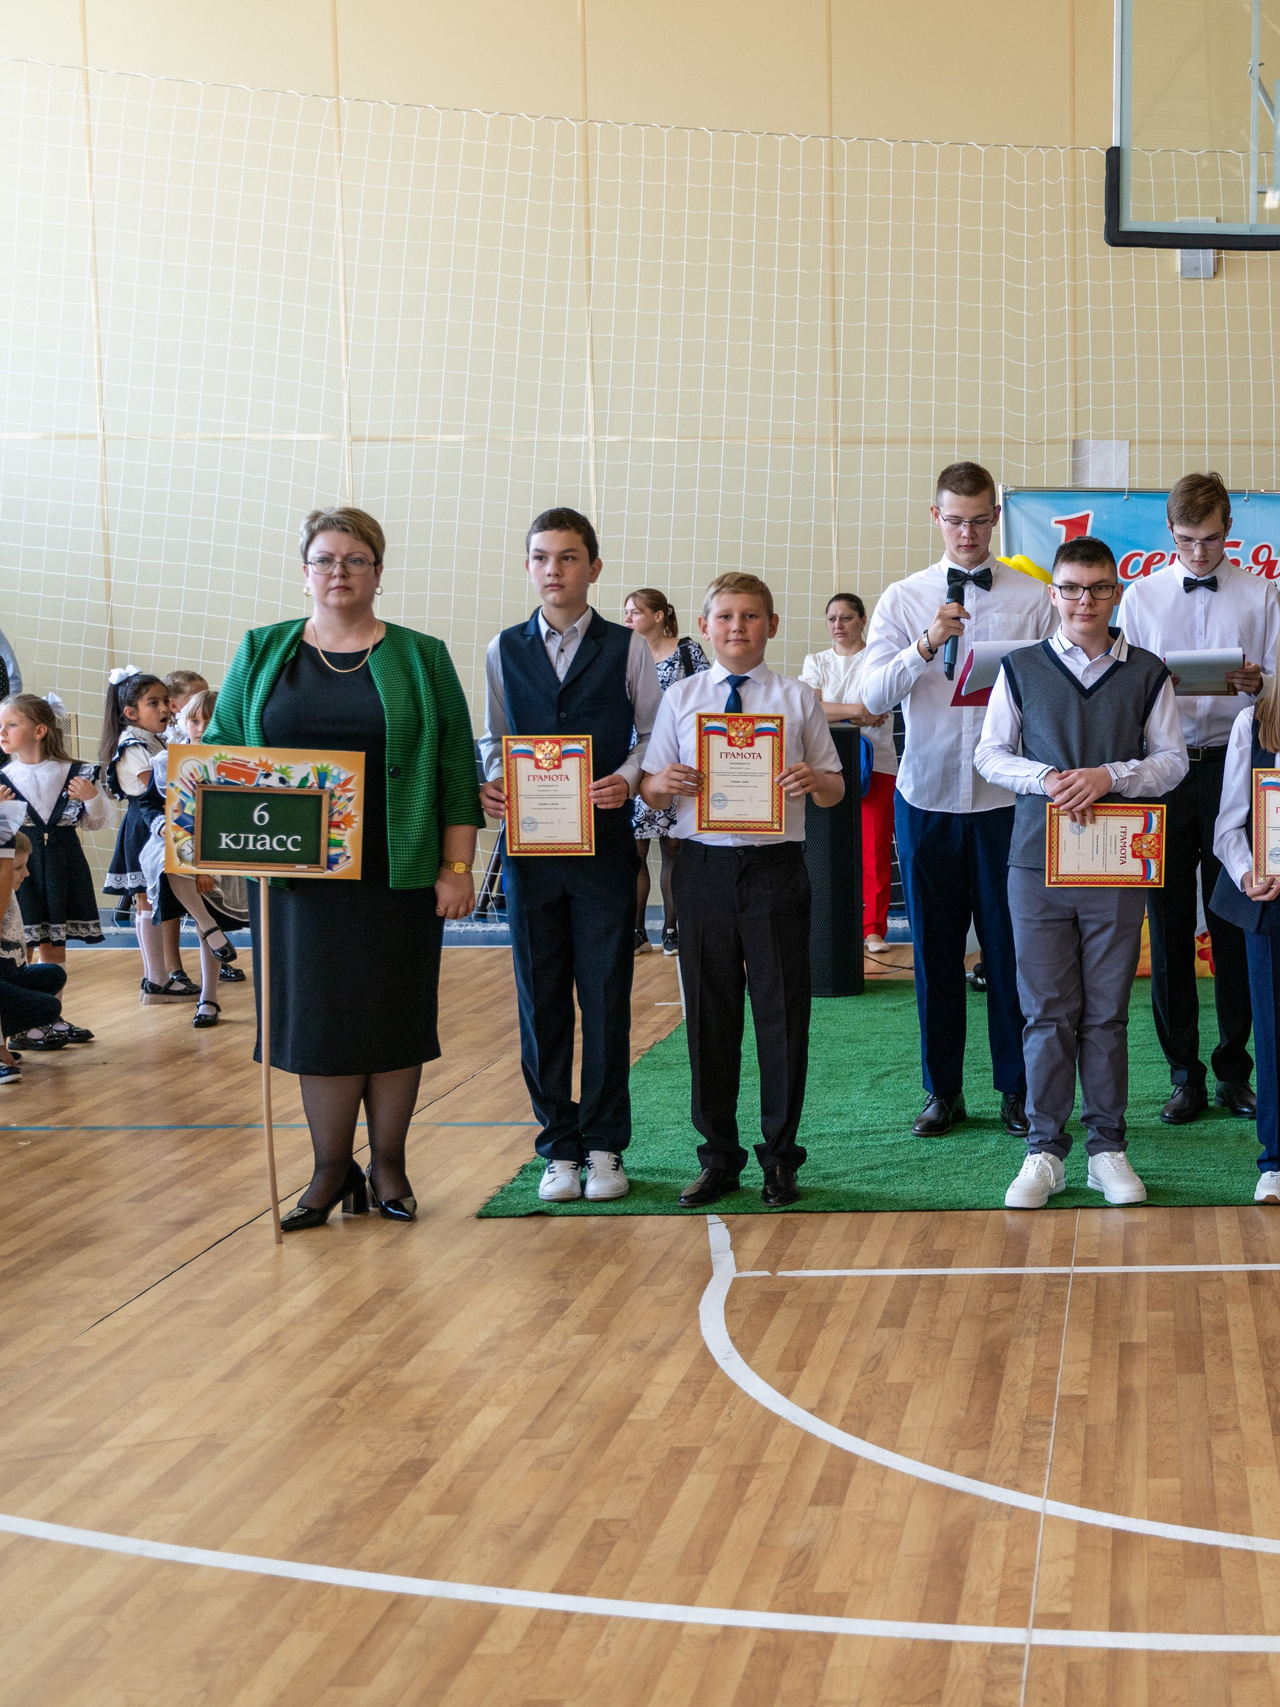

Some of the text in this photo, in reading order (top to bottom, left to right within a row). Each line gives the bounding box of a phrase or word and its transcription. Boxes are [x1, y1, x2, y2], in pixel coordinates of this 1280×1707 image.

[719, 751, 762, 760] ГРАМОТА
[527, 774, 570, 782] ГРАМОТА
[253, 802, 270, 826] 6
[218, 832, 302, 851] класс
[1119, 825, 1128, 866] ГРАМОТА
